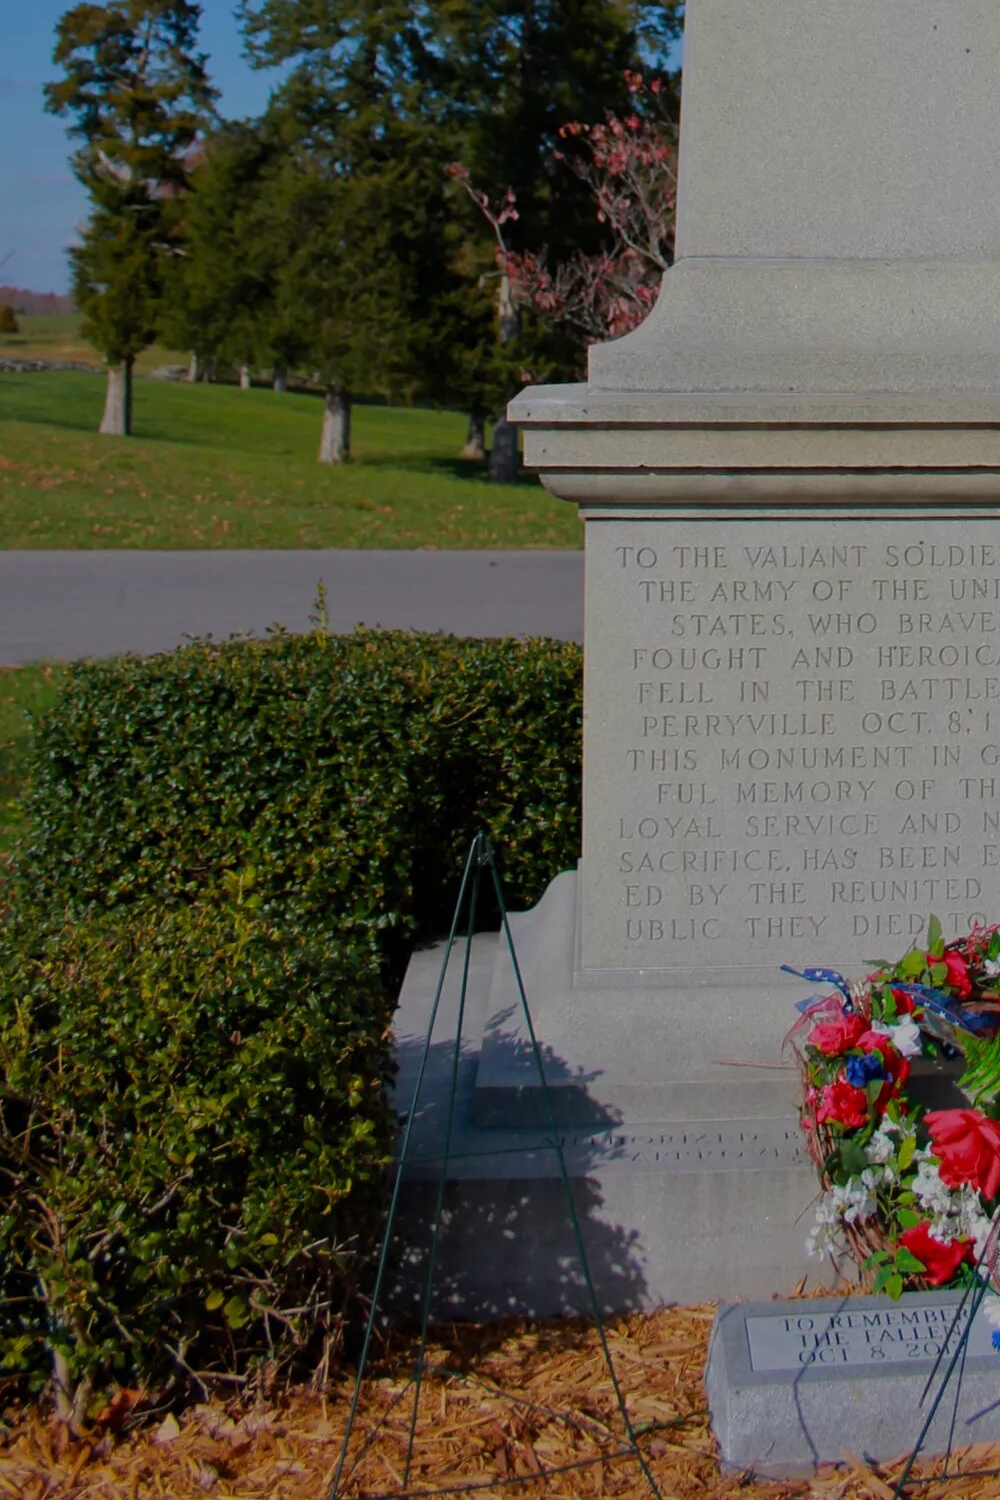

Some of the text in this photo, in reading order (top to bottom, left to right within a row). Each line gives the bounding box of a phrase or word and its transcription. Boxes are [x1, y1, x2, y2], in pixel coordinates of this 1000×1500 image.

[616, 547, 658, 569] TO
[673, 546, 728, 568] THE
[745, 545, 868, 568] VALIANT
[639, 580, 695, 603] THE
[711, 579, 797, 602] ARMY
[812, 579, 851, 601] OF
[873, 578, 929, 601] THE
[672, 613, 794, 637] STATES,
[808, 612, 877, 636] WHO
[633, 647, 767, 670] FOUGHT
[792, 646, 854, 669] AND
[639, 681, 713, 704] FELL
[740, 680, 769, 703] IN
[797, 679, 855, 702] THE
[881, 677, 1000, 701] BATTLE
[642, 712, 835, 737] PERRYVILLE
[862, 711, 932, 735] OCT.
[627, 748, 697, 771] THIS
[721, 745, 913, 770] MONUMENT
[933, 744, 961, 767] IN
[658, 782, 716, 804] FUL
[737, 779, 874, 803] MEMORY
[896, 778, 935, 800] OF
[620, 815, 721, 839] LOYAL
[746, 812, 879, 837] SERVICE
[900, 811, 961, 835] AND
[620, 848, 790, 873] SACRIFICE,
[803, 847, 855, 870] HAS
[879, 845, 961, 868] BEEN
[627, 884, 661, 907] ED
[690, 883, 726, 906] BY
[748, 881, 806, 905] THE
[831, 878, 980, 903] REUNITED
[627, 916, 721, 940] UBLIC
[745, 914, 827, 938] THEY
[852, 912, 924, 936] DIED
[951, 911, 988, 935] TO
[783, 1308, 968, 1332] TO REMEMBER
[796, 1325, 962, 1347] THE FALLEN
[798, 1348, 851, 1364] OCT
